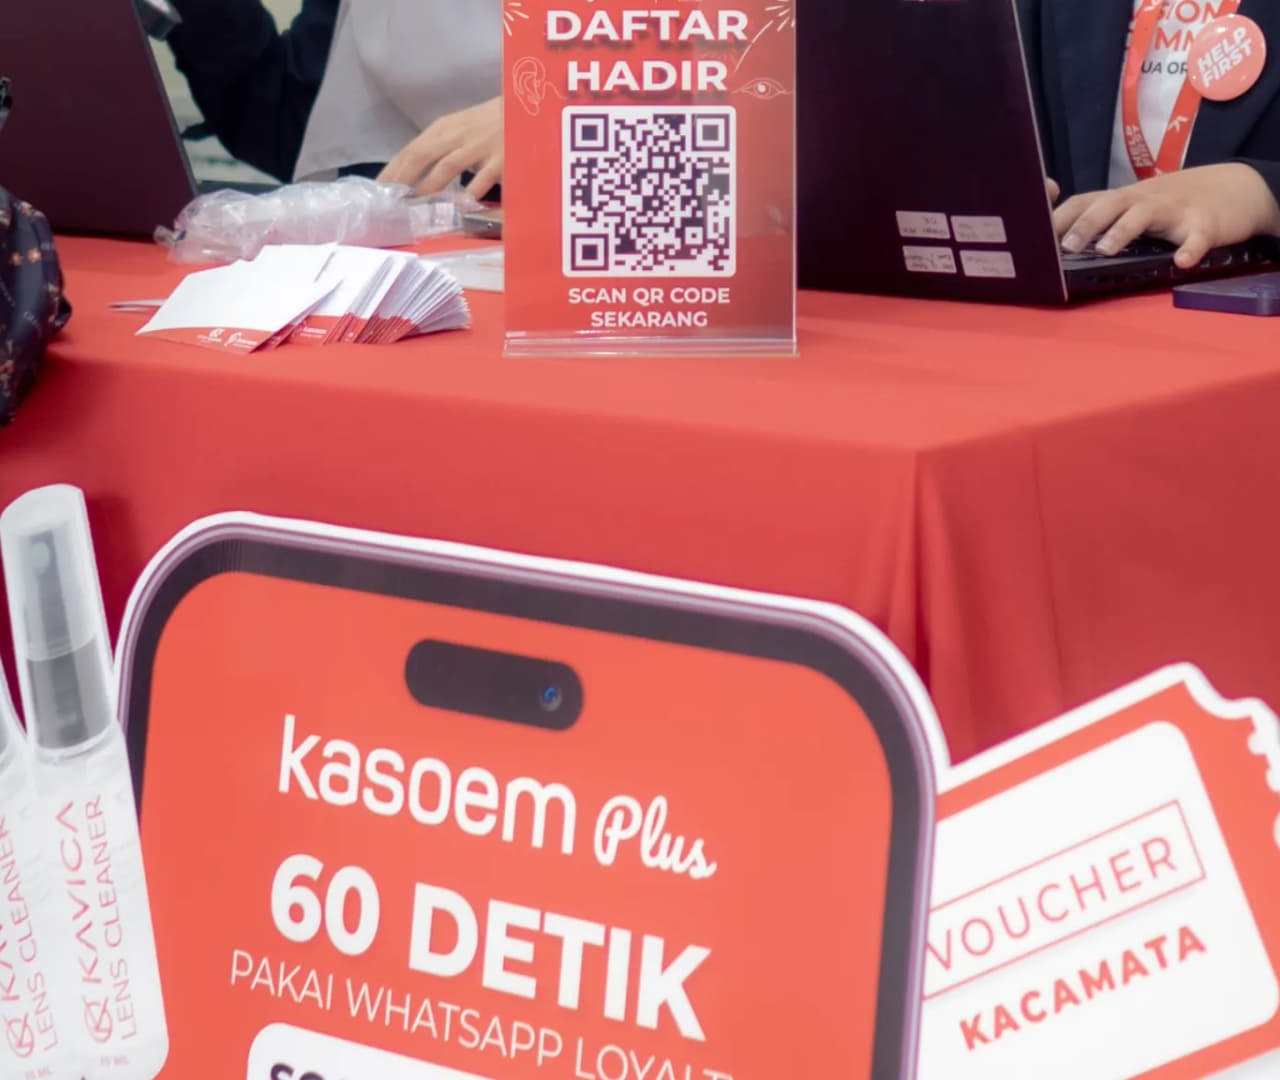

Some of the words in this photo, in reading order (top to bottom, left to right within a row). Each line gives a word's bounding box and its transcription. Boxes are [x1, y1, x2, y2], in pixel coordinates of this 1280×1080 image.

[546, 9, 749, 41] DAFTAR
[1197, 27, 1247, 72] HELP
[1199, 38, 1252, 88] FIRST
[567, 60, 728, 91] HADIR
[568, 287, 627, 304] SCAN
[632, 287, 665, 306] QR
[670, 287, 731, 304] CODE
[591, 311, 708, 327] SEKARANG
[278, 714, 577, 855] kasoem
[594, 796, 717, 879] Plus
[56, 801, 102, 984] KAVICA
[85, 794, 123, 948] CLEANER
[926, 835, 1179, 970] VOUCHER
[270, 854, 380, 956] 60
[409, 882, 711, 1043] DETIK
[959, 924, 1208, 1051] KACAMATA
[27, 971, 58, 1051] LENS
[110, 958, 137, 1040] LENS
[229, 949, 334, 1010] PAKAI
[345, 977, 564, 1065] WHATSAPP
